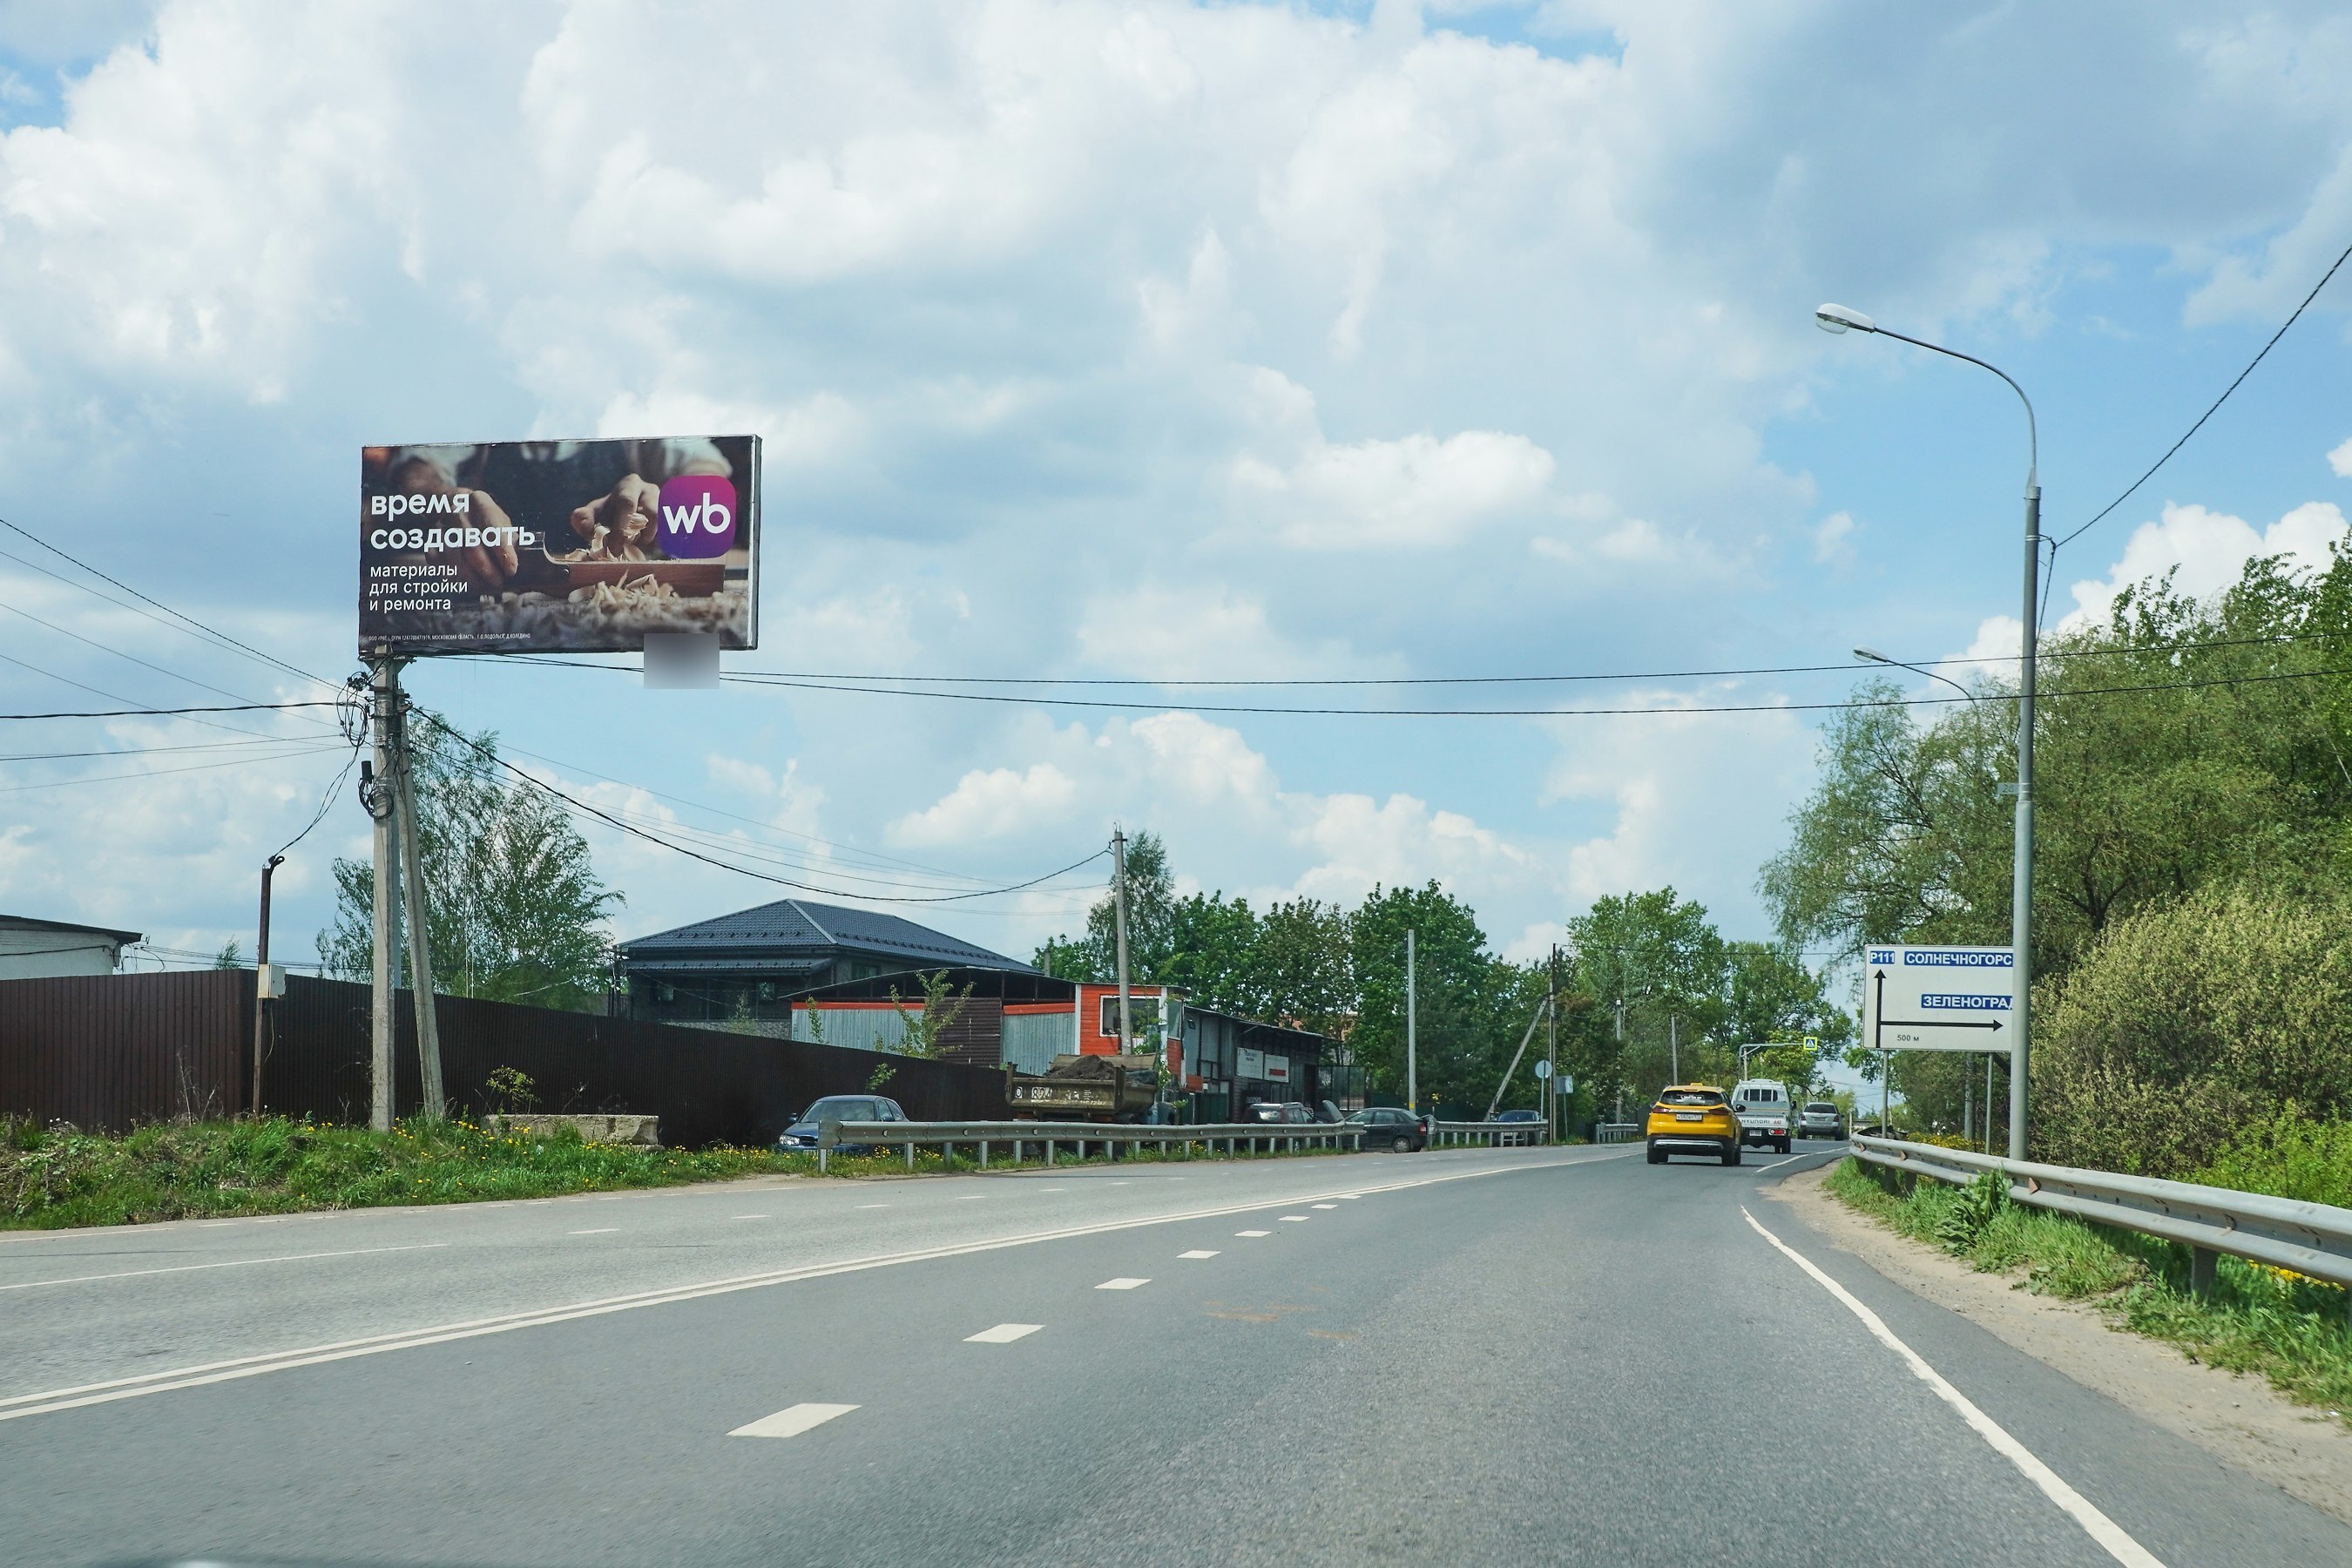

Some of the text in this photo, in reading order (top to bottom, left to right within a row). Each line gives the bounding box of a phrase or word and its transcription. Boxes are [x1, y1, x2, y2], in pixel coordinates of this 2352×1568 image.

[371, 493, 470, 522] время
[662, 492, 731, 534] wb
[370, 526, 536, 553] создавать
[370, 564, 457, 579] материалы
[369, 579, 468, 597] для стройки
[369, 598, 451, 614] и ремонта
[1905, 952, 2012, 965] СОЛНЕЧНОГОРС
